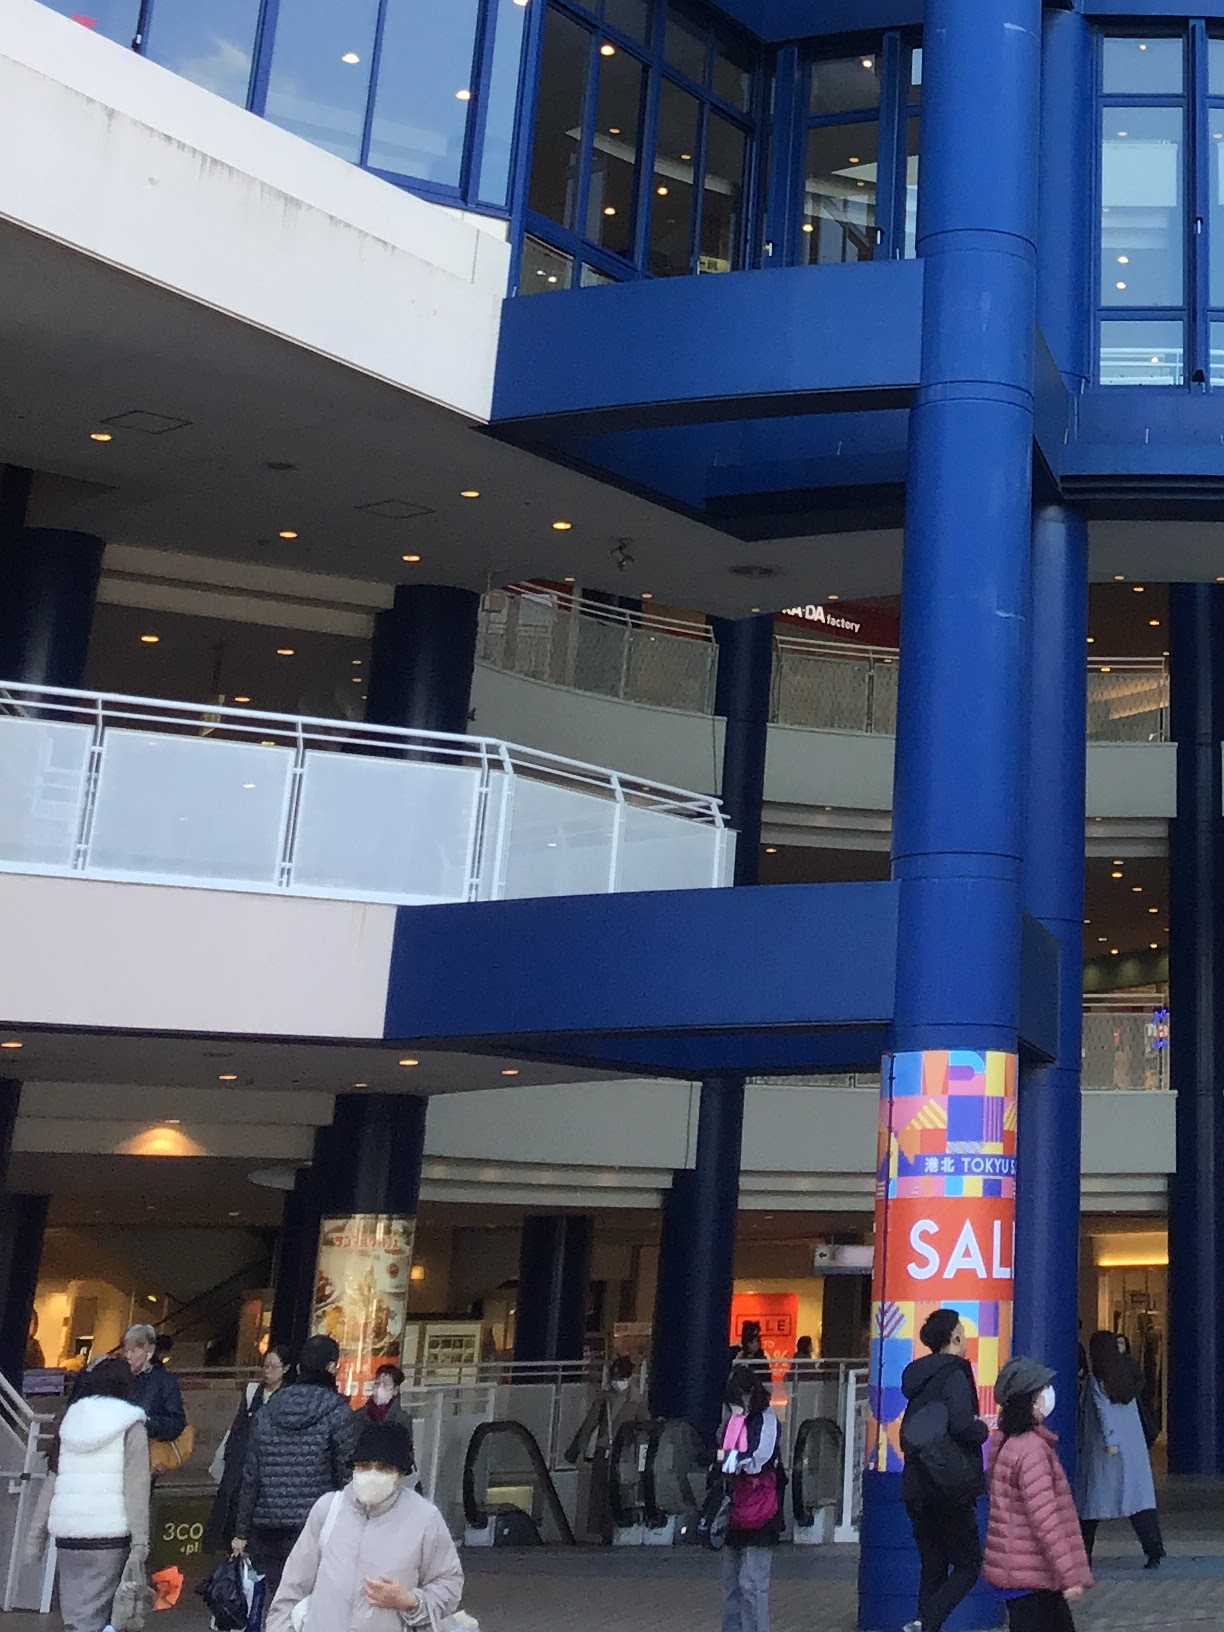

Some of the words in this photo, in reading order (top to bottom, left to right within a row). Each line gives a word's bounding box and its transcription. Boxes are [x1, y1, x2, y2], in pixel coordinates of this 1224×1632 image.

[826, 614, 861, 633] factory
[924, 1156, 955, 1173] 港北
[960, 1157, 1009, 1175] TOKYU
[906, 1218, 1016, 1281] SAL
[163, 1522, 204, 1541] 3CO
